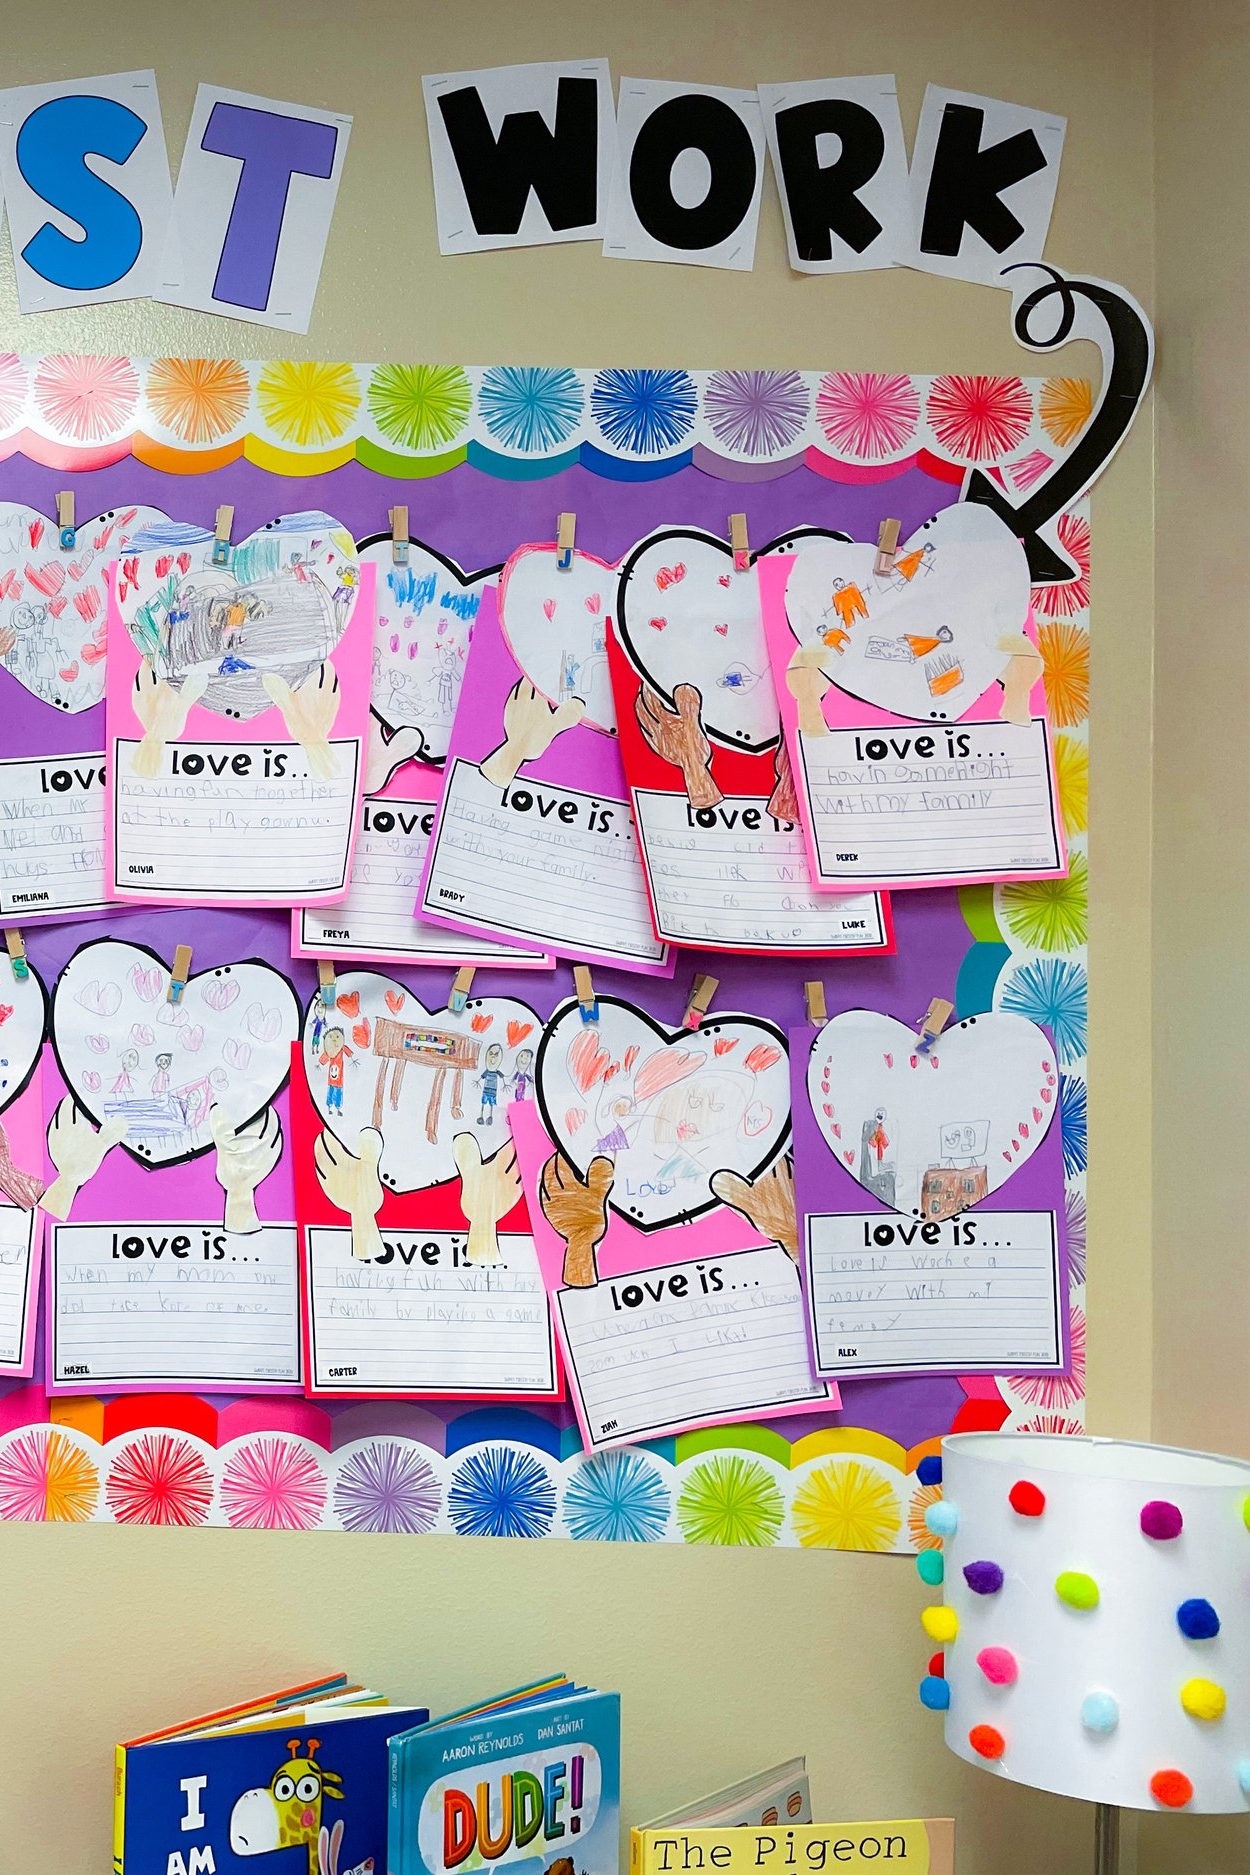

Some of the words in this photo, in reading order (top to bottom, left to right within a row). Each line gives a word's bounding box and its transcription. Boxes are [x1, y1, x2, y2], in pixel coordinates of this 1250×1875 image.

[437, 77, 1047, 261] WORK
[855, 735, 935, 761] love
[172, 750, 252, 776] love
[500, 787, 578, 824] love
[128, 865, 154, 874] OLIVIA
[836, 853, 859, 862] DEREK
[12, 891, 49, 904] EMILIANA
[439, 888, 465, 902] BRADY
[323, 929, 350, 939] FREYA
[842, 920, 866, 930] LUKE
[112, 1233, 192, 1259] love
[864, 1221, 941, 1247] love
[610, 1274, 688, 1310] love
[838, 1348, 858, 1357] ALEX
[64, 1365, 90, 1375] HAZEL
[329, 1367, 358, 1377] CARTER
[538, 1727, 554, 1741] DAN
[556, 1718, 585, 1735] SANTAT
[442, 1742, 476, 1763] AARON
[478, 1732, 524, 1755] REYNOLDS
[180, 1775, 207, 1832] I
[443, 1755, 585, 1869] DUDE!
[167, 1845, 216, 1875] AM
[654, 1837, 732, 1871] The
[754, 1832, 907, 1871] Pigeon
